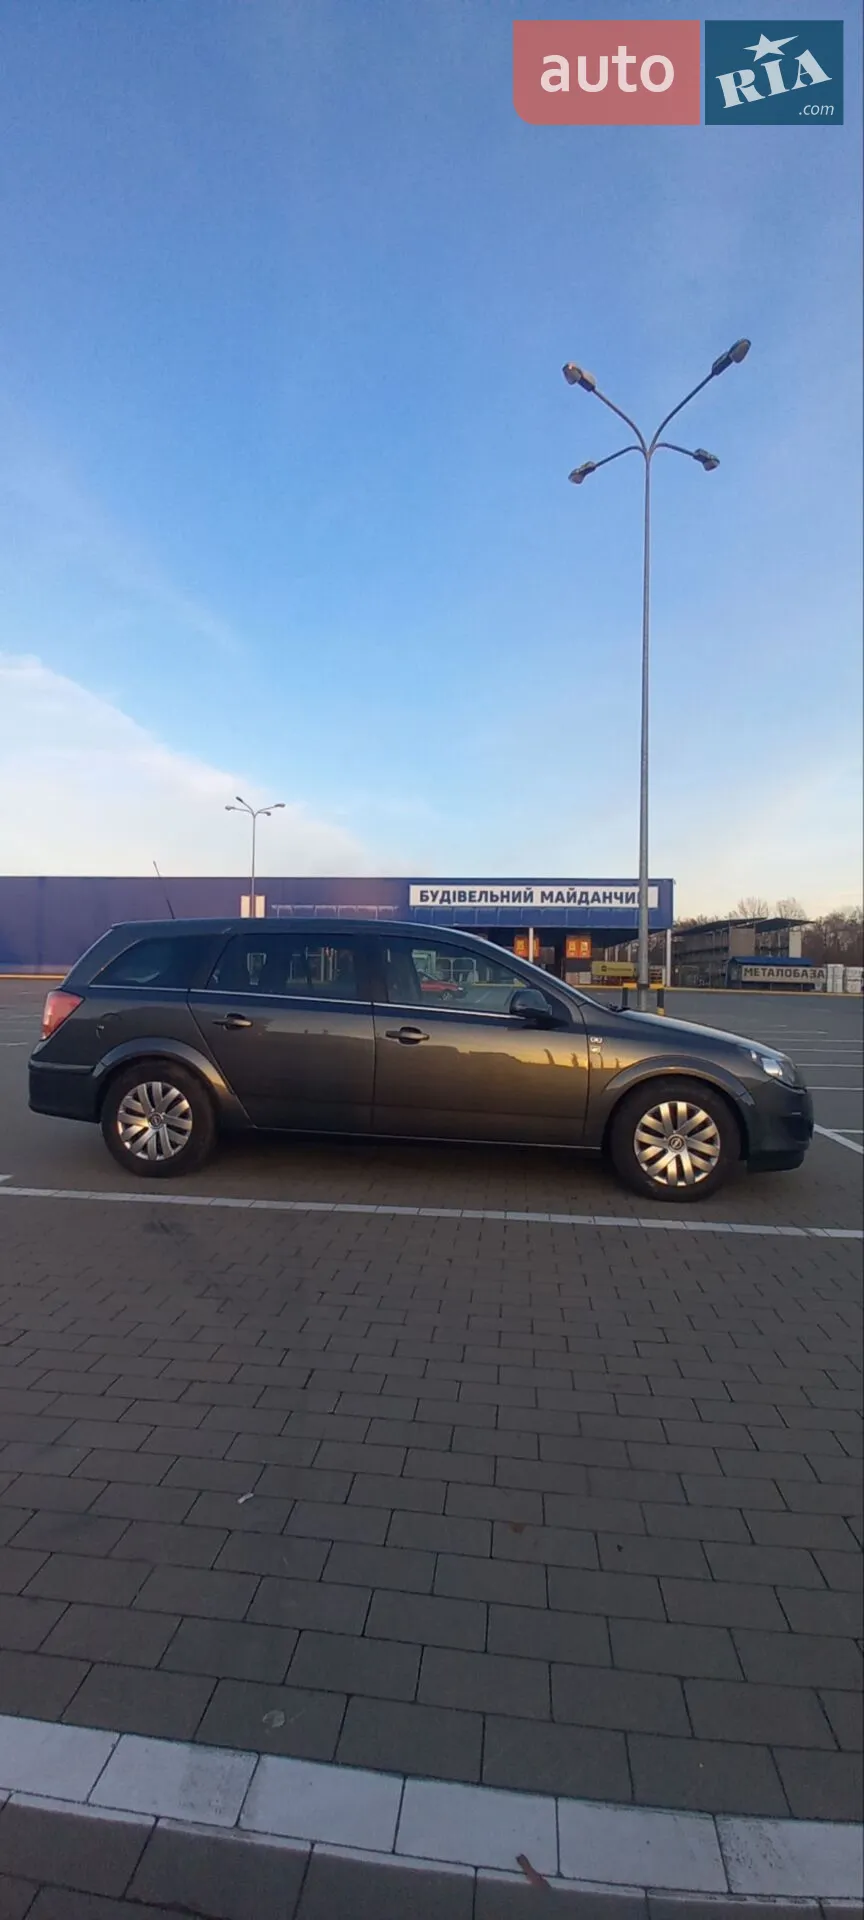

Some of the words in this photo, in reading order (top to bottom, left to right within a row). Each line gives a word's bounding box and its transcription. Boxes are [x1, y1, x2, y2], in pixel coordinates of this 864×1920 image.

[419, 888, 534, 904] БУДІВЕЛЬНИЙ
[540, 888, 641, 905] МАЙДАНЧИ
[743, 967, 825, 979] МЕТАЛОБАЗА
